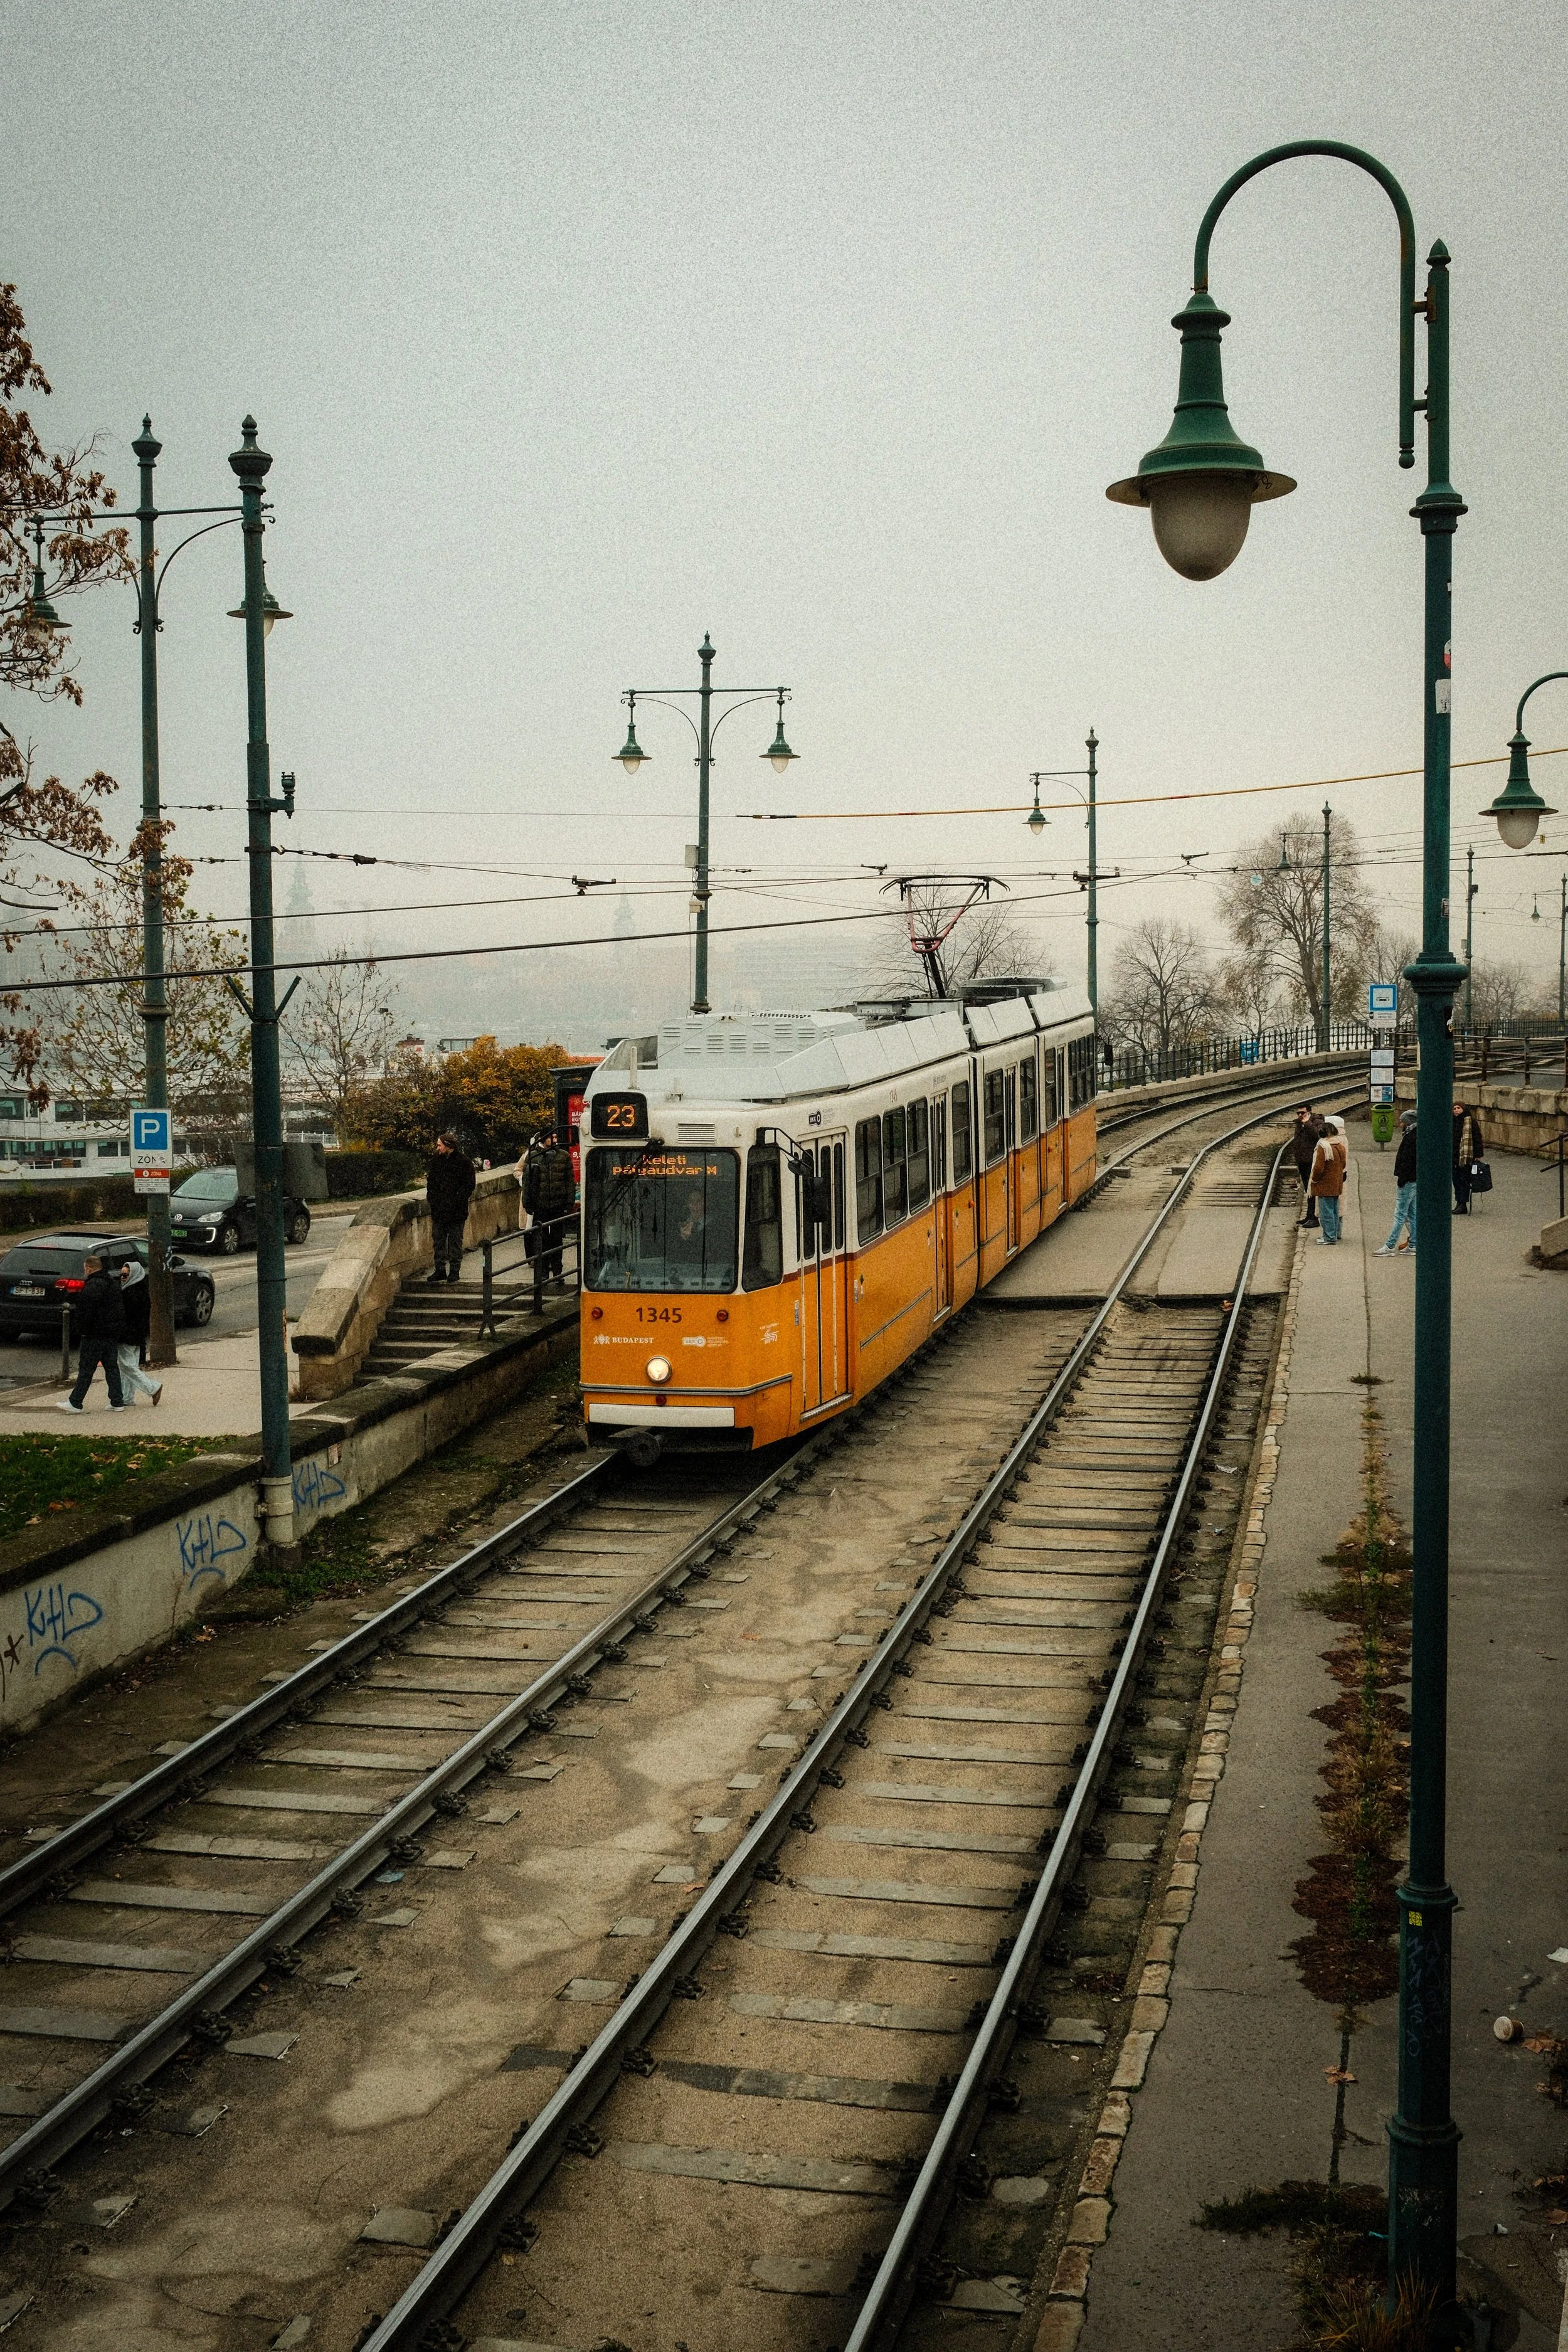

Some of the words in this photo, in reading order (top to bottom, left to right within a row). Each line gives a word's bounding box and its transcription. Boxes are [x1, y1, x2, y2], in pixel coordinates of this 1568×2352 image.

[607, 1105, 635, 1126] 23
[141, 1119, 160, 1143] P
[706, 1165, 718, 1175] M
[635, 1307, 682, 1323] 1345
